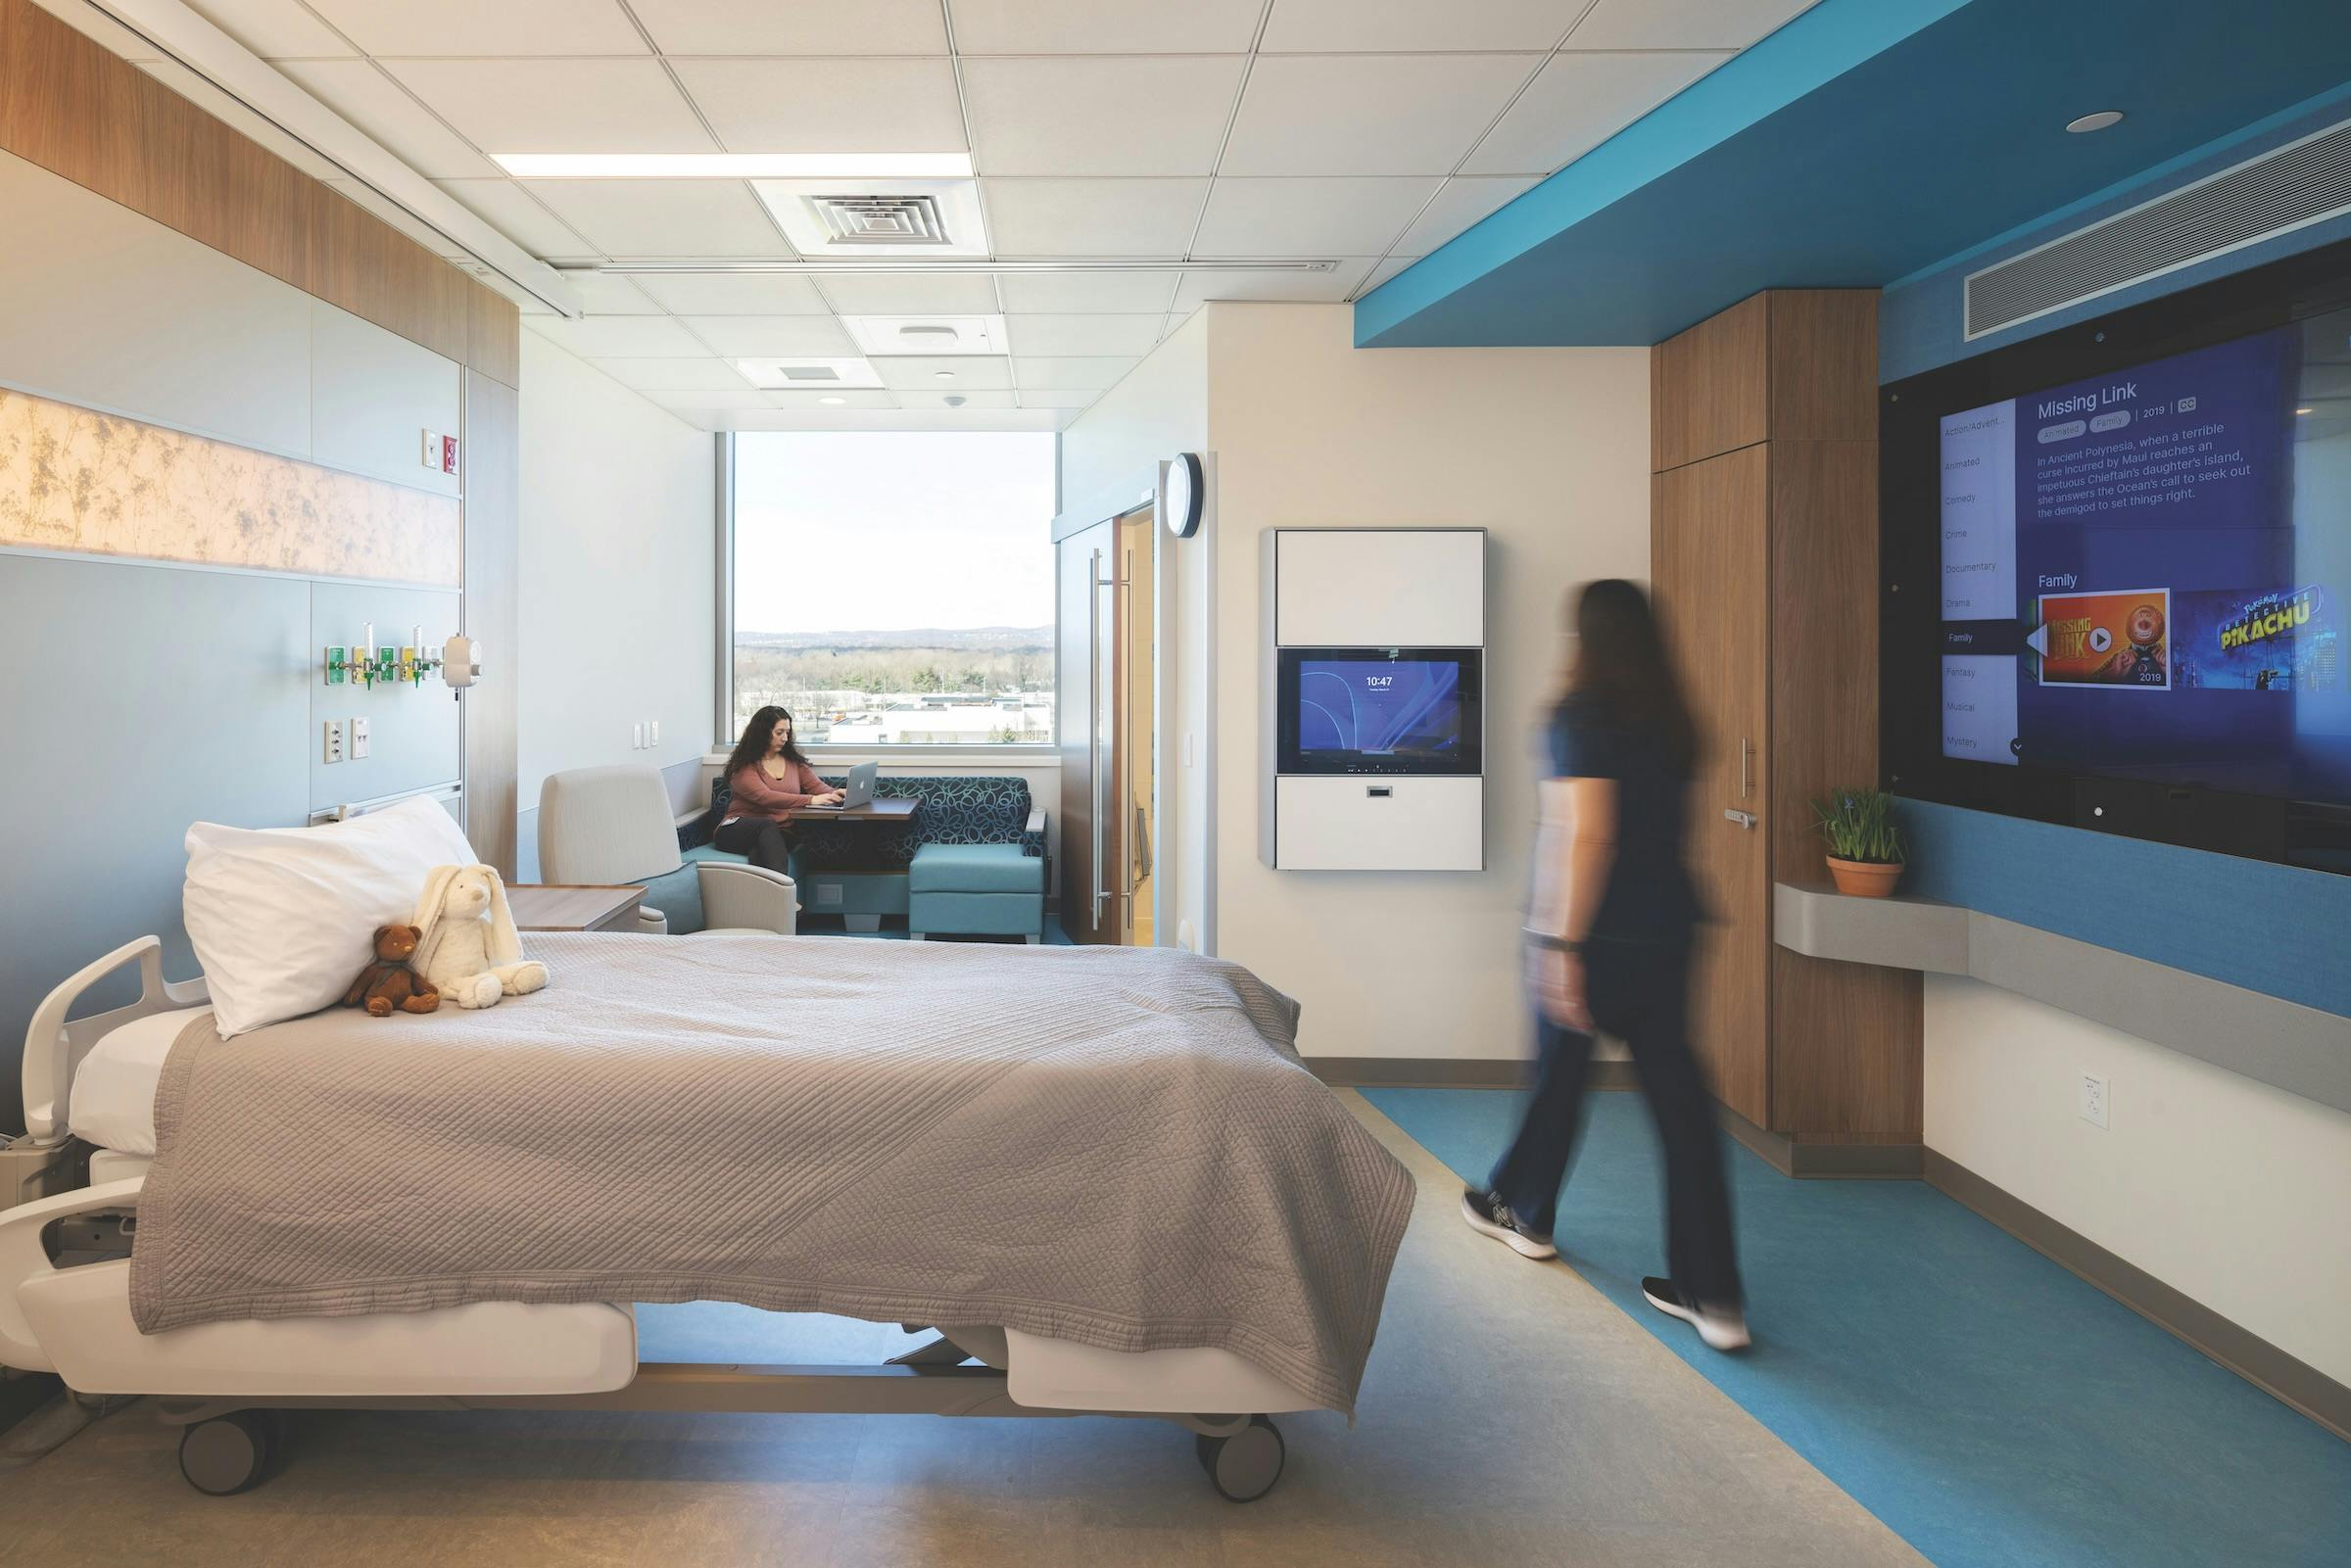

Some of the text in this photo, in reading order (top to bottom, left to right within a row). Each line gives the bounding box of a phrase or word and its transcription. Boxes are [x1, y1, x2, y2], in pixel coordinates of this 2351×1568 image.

[2039, 382, 2137, 419] Missing Link
[2044, 399, 2194, 439] Animated Family 2019 CC
[2048, 451, 2083, 464] Ancient
[2086, 440, 2135, 457] Polynesia,
[2140, 435, 2168, 447] when
[2183, 424, 2225, 439] terrible
[1944, 457, 1980, 470] Animated
[2038, 442, 2213, 479] curse incurred by Maui reaches an
[2038, 451, 2243, 493] impetuous Chieftain's daughter's island,
[2038, 465, 2251, 506] she answers the Ocean's call to seek out
[1944, 494, 1976, 505] Comedy
[2038, 489, 2195, 518] the demigod to set things right.
[1945, 563, 1996, 574] Documentary
[2039, 574, 2077, 588] Family
[1948, 634, 1973, 643] Family
[1366, 676, 1392, 687] 10:47
[2140, 673, 2161, 682] 2019
[1946, 737, 1977, 748] Mystery
